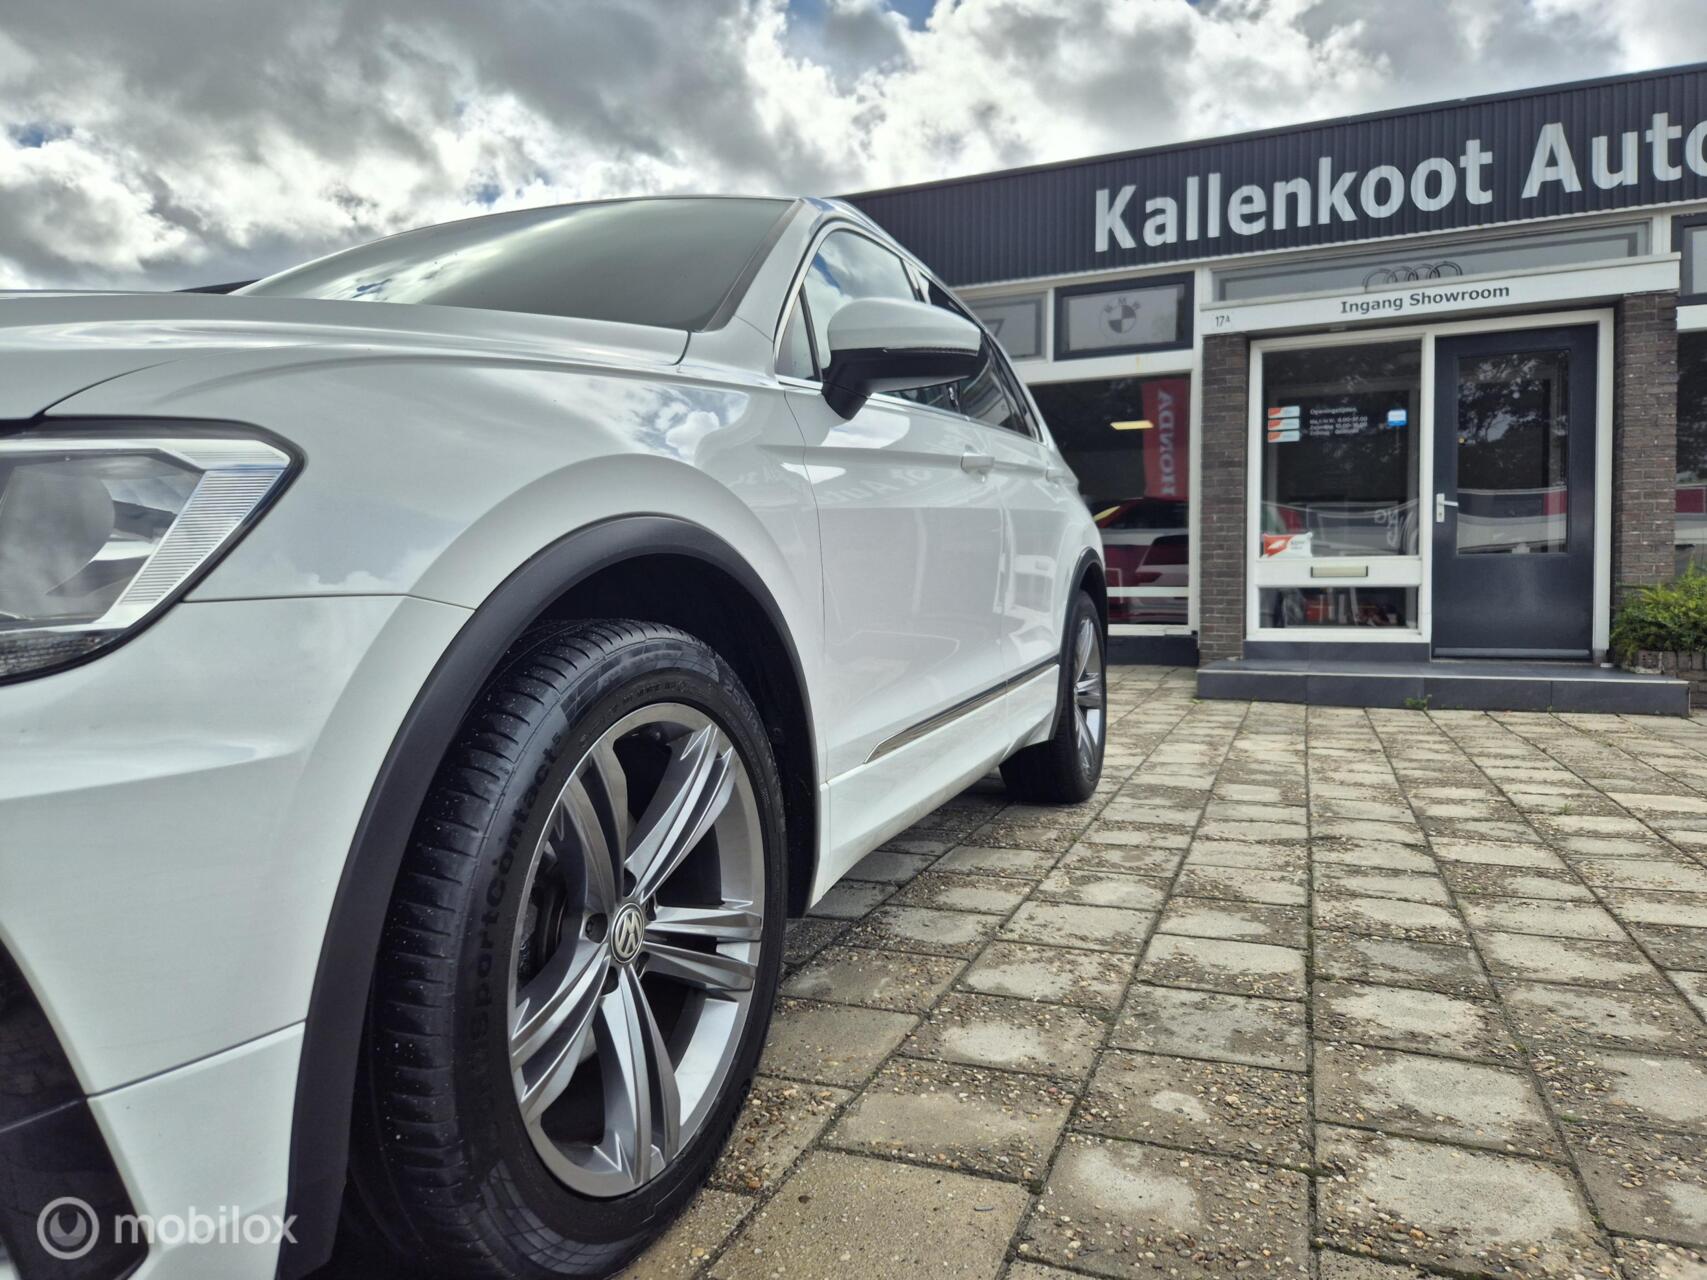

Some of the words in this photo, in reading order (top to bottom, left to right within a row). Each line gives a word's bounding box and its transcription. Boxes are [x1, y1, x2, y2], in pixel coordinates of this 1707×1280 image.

[1094, 138, 1494, 253] Kallenkoot
[1340, 297, 1404, 316] Ingang
[1409, 285, 1510, 307] Showroom
